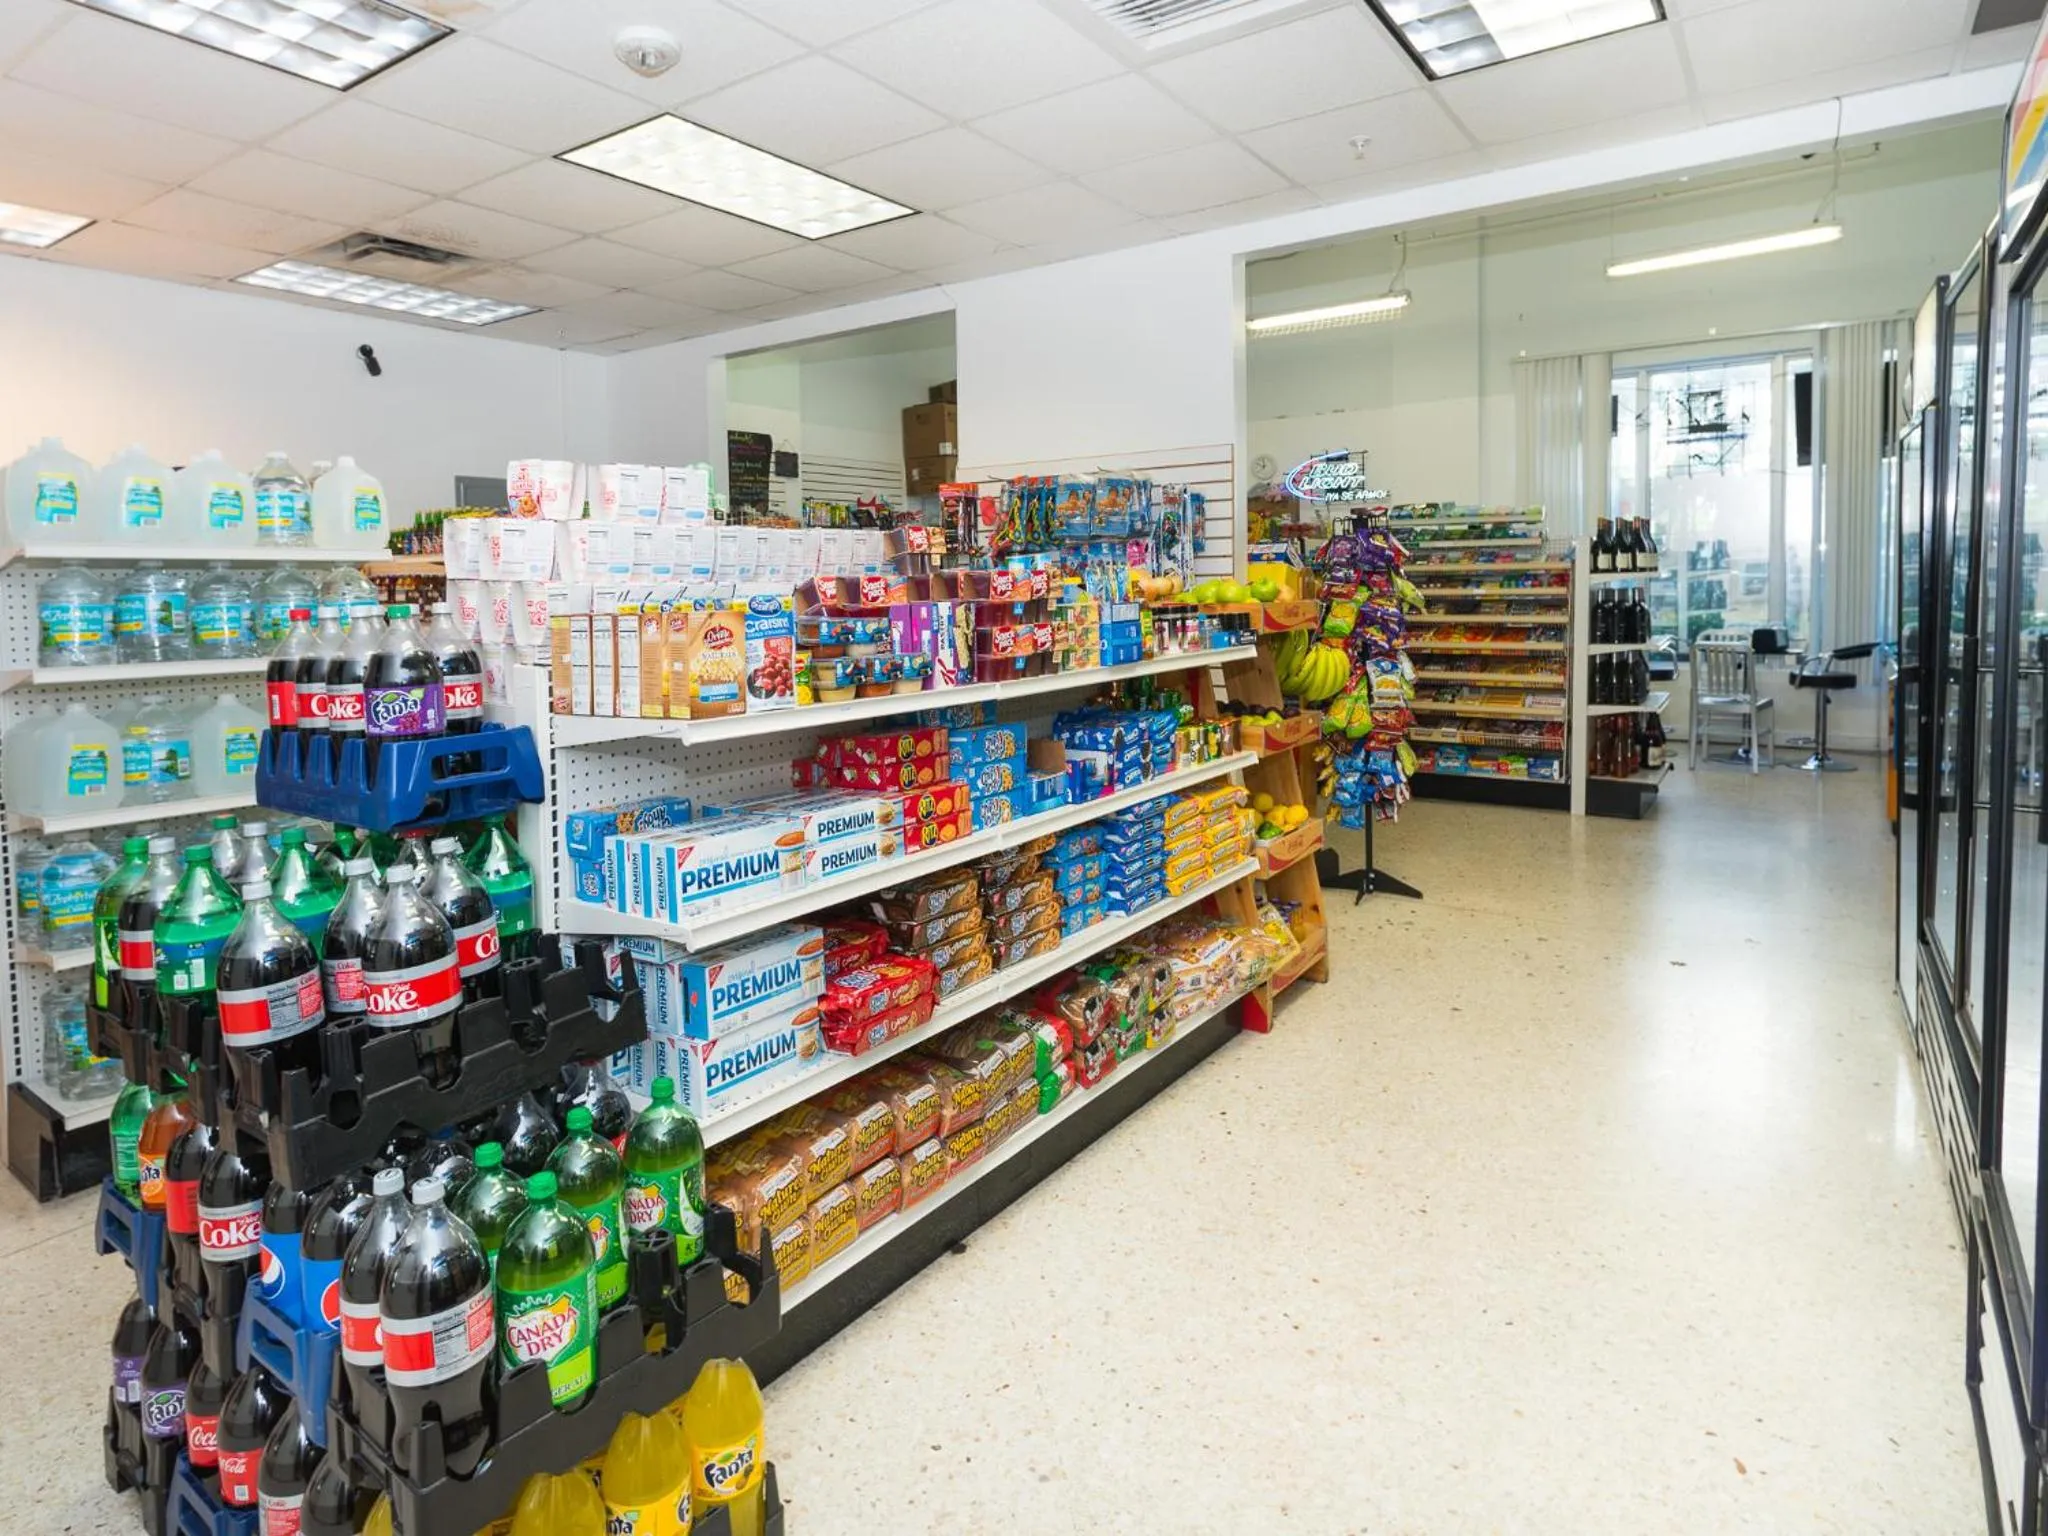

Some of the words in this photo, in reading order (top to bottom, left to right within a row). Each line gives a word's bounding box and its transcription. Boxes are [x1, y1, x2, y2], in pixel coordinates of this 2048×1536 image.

[1299, 475, 1366, 490] LIGHT
[1310, 462, 1360, 477] BUD
[1341, 491, 1354, 501] SE
[371, 696, 421, 726] Fanta
[818, 811, 875, 838] PREMIUM
[681, 850, 780, 894] PREMIUM
[821, 843, 878, 872] PREMIUM
[606, 849, 616, 900] PREMIUM
[631, 852, 641, 905] PREMIUM
[656, 856, 667, 910] PREMIUM
[475, 932, 500, 958] Co
[617, 937, 656, 954] PREMIUM
[656, 967, 668, 1025] PREMIUM
[712, 958, 801, 1012] PREMIUM
[656, 1041, 668, 1077] PREM
[707, 1030, 796, 1088] PREMIUM
[680, 1048, 692, 1107] PREMIUM
[199, 1216, 261, 1247] Coke
[629, 1210, 654, 1225] DRY
[506, 1307, 578, 1350] CANADA
[526, 1333, 566, 1358] DRY
[148, 1395, 186, 1424] Fant
[704, 1449, 754, 1490] Fanta
[607, 1517, 634, 1536] nta
